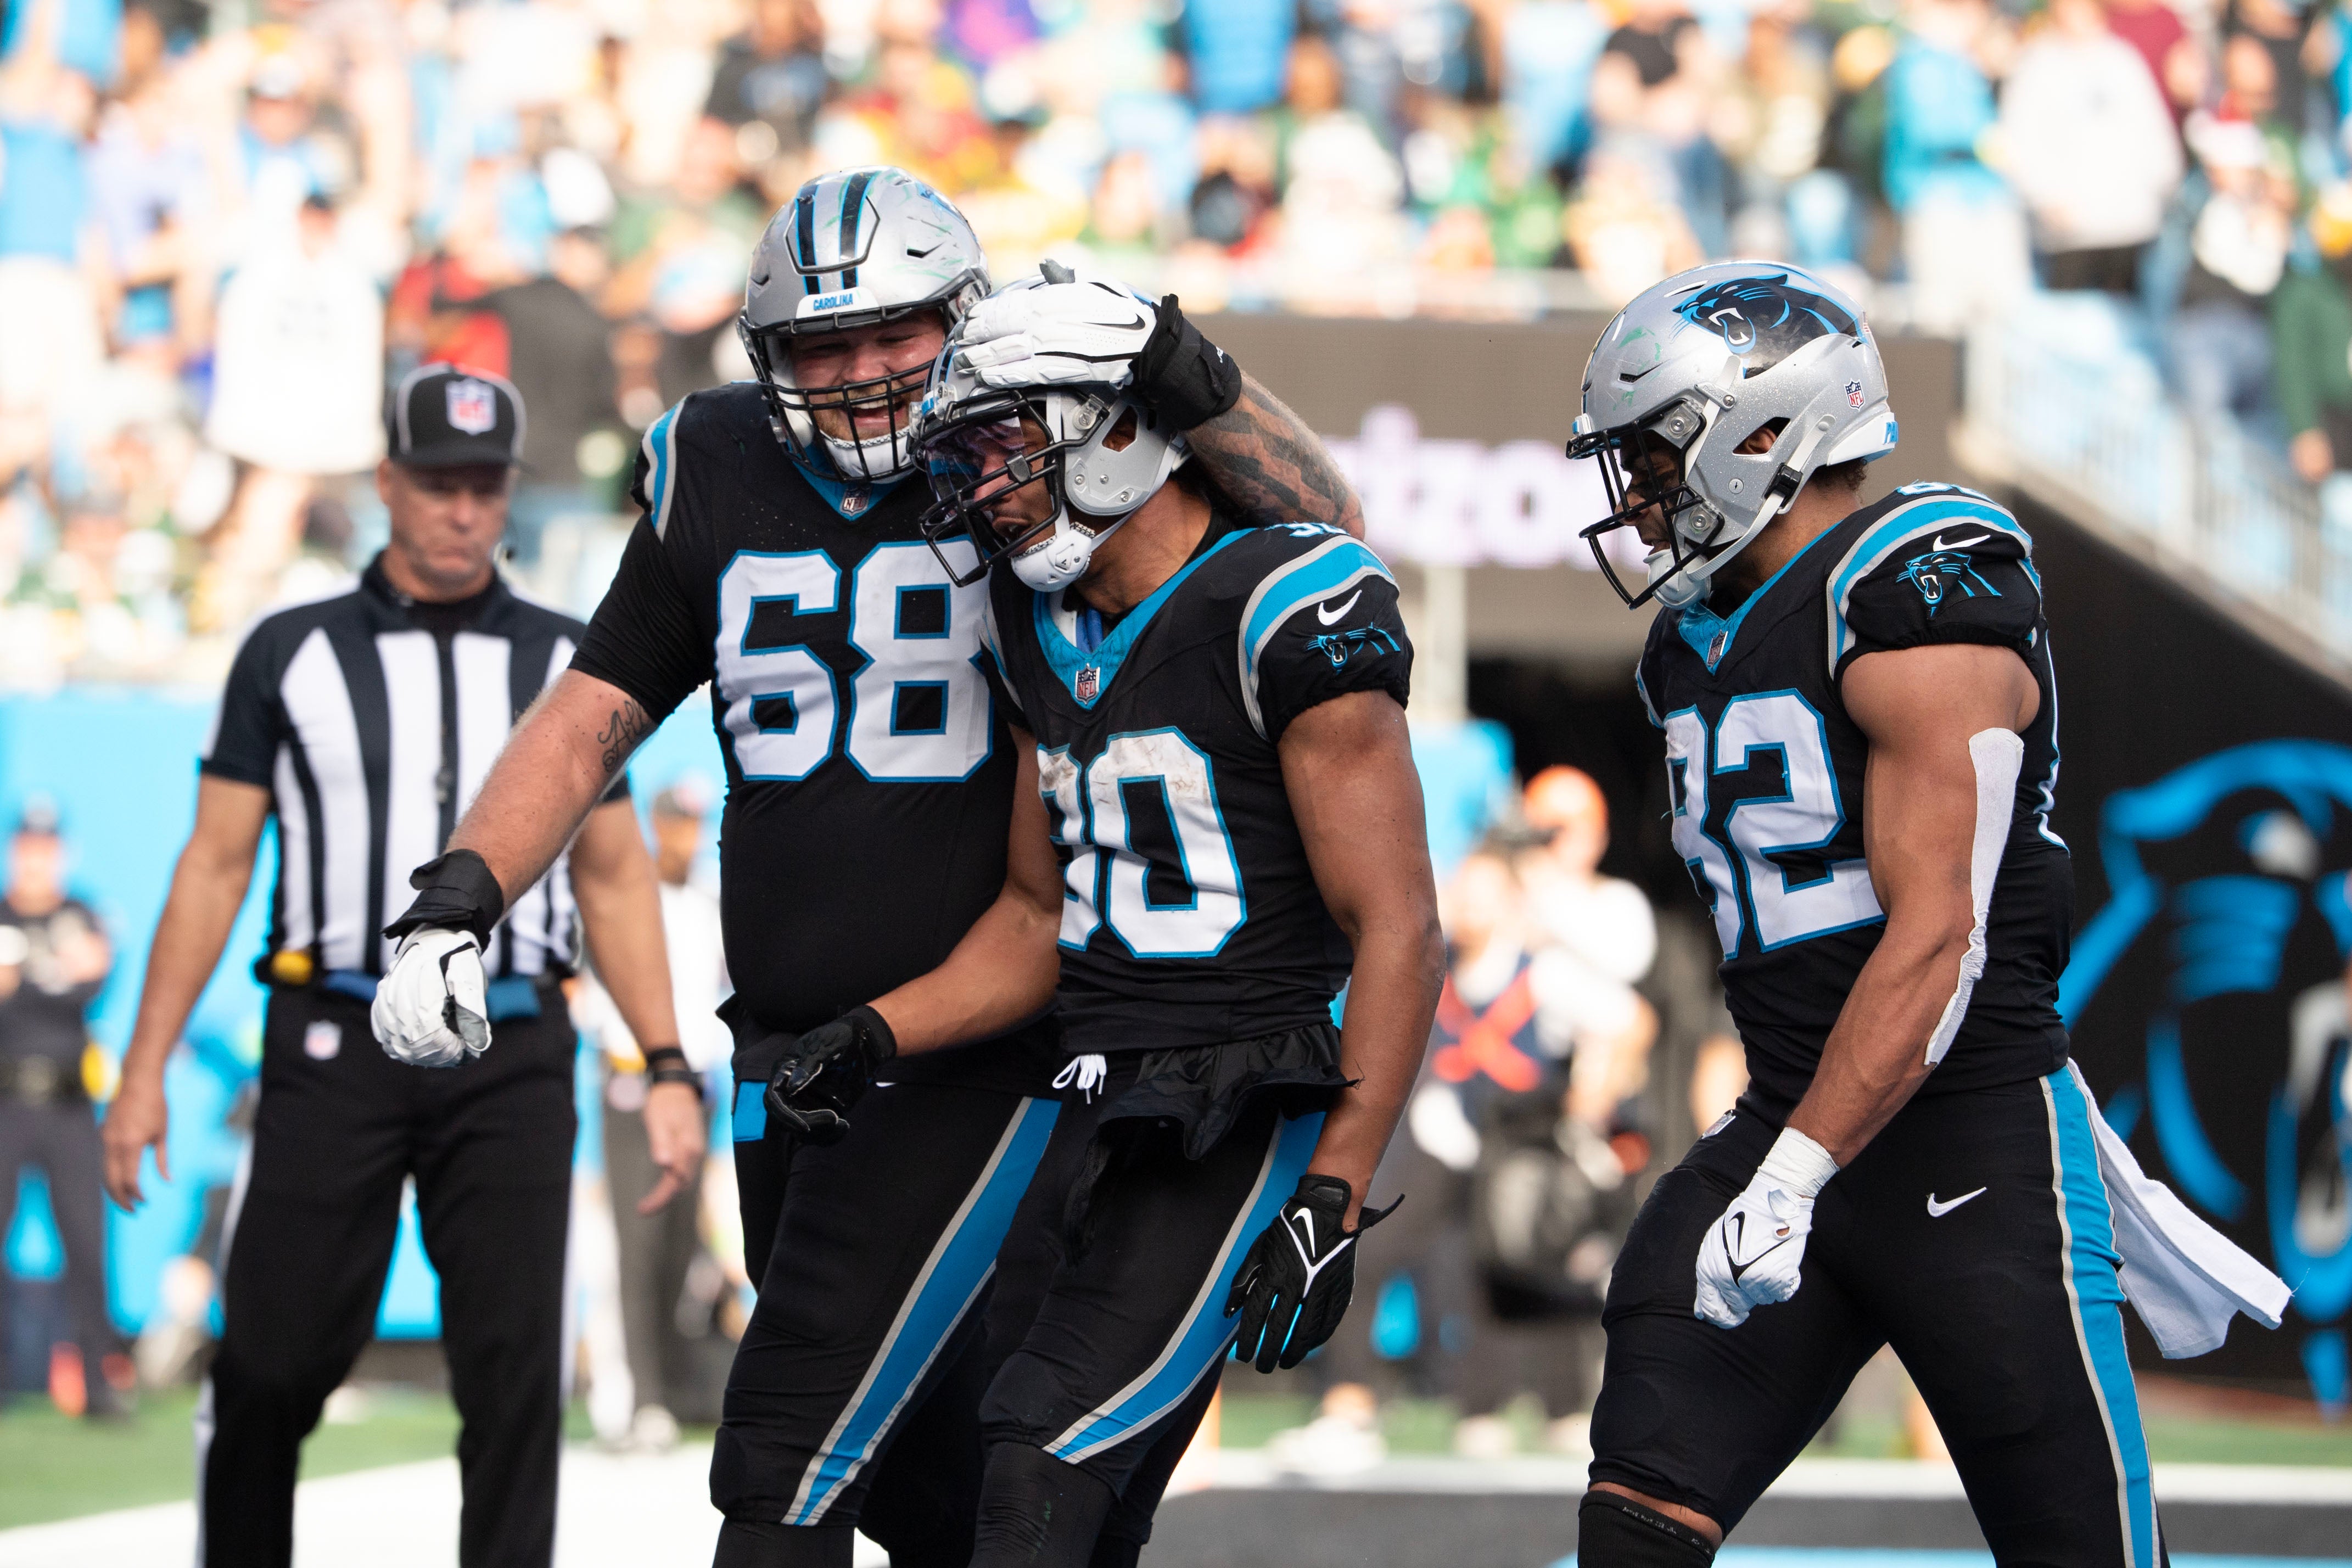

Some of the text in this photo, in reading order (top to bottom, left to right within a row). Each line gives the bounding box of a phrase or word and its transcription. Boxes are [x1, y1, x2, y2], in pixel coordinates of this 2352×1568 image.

[814, 294, 853, 311] CAROLINA
[1849, 391, 1863, 406] NFL
[844, 497, 866, 511] NFL
[715, 534, 993, 782] 68
[1078, 681, 1094, 697] NFL
[1664, 688, 1888, 960] 82
